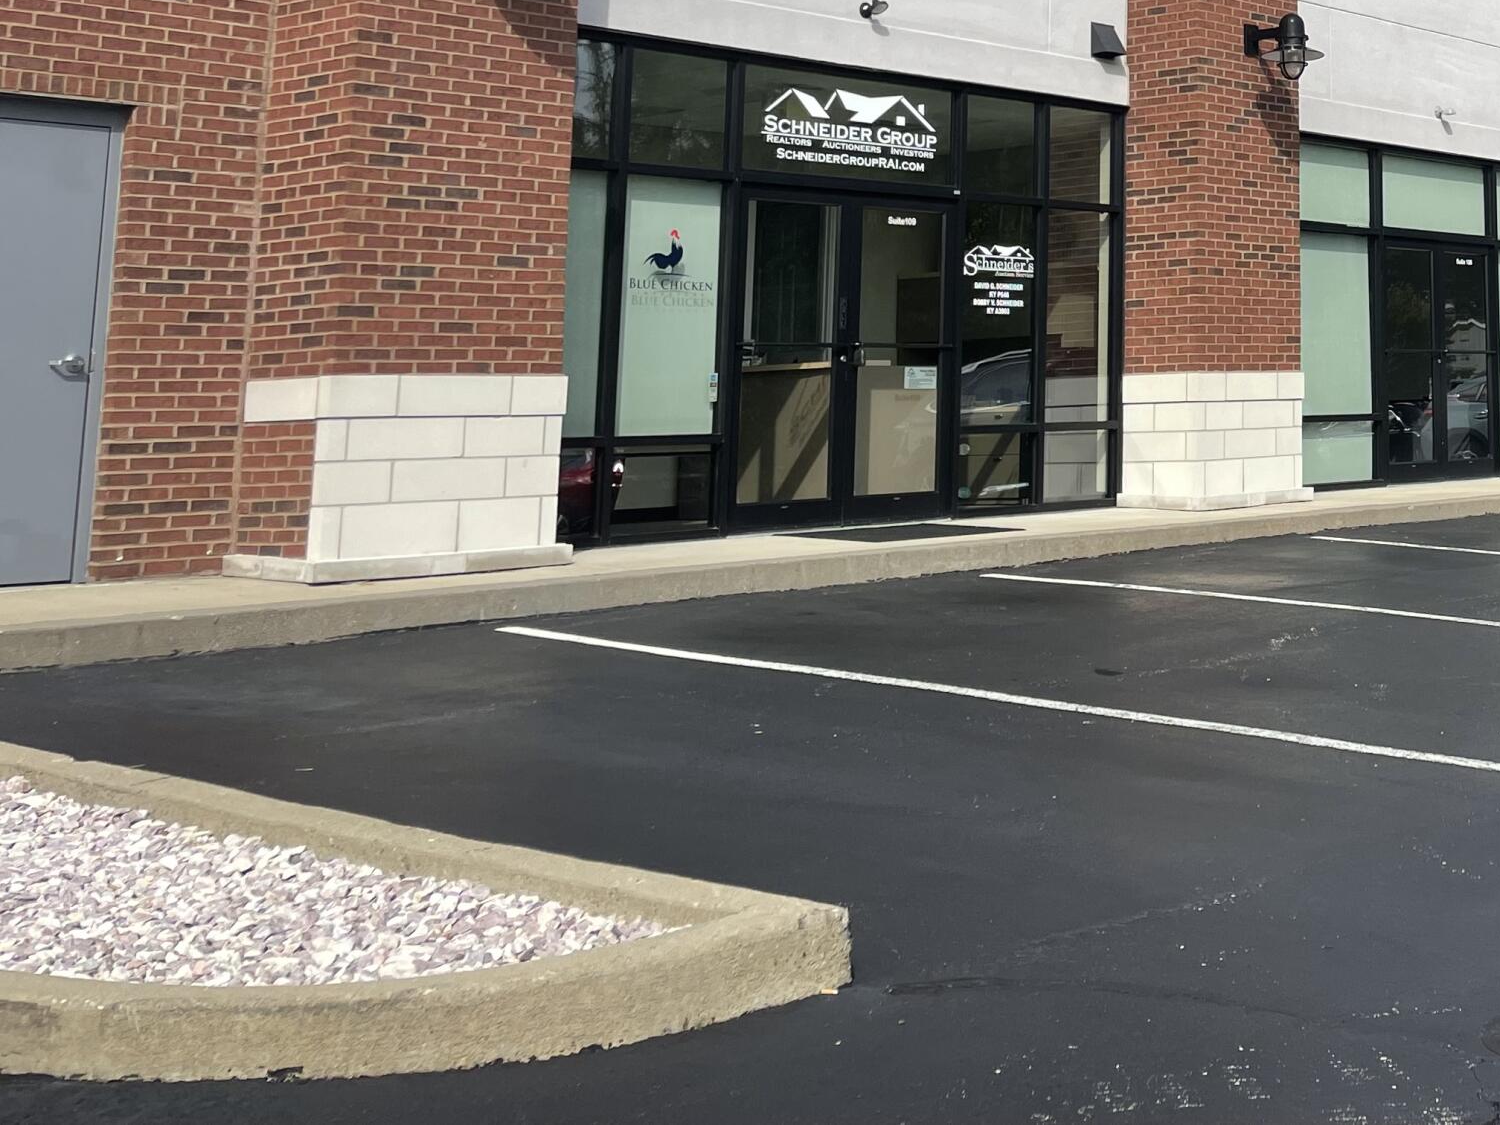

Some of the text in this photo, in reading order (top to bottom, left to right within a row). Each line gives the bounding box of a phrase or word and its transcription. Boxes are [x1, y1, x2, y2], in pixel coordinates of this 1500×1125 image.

[764, 115, 937, 148] SCHNEIDER GROUP
[766, 135, 934, 159] REALTORS AUCTIONEERS INVESTORS
[963, 253, 1034, 276] Schneider's
[629, 277, 713, 291] BLUE CHICKEN
